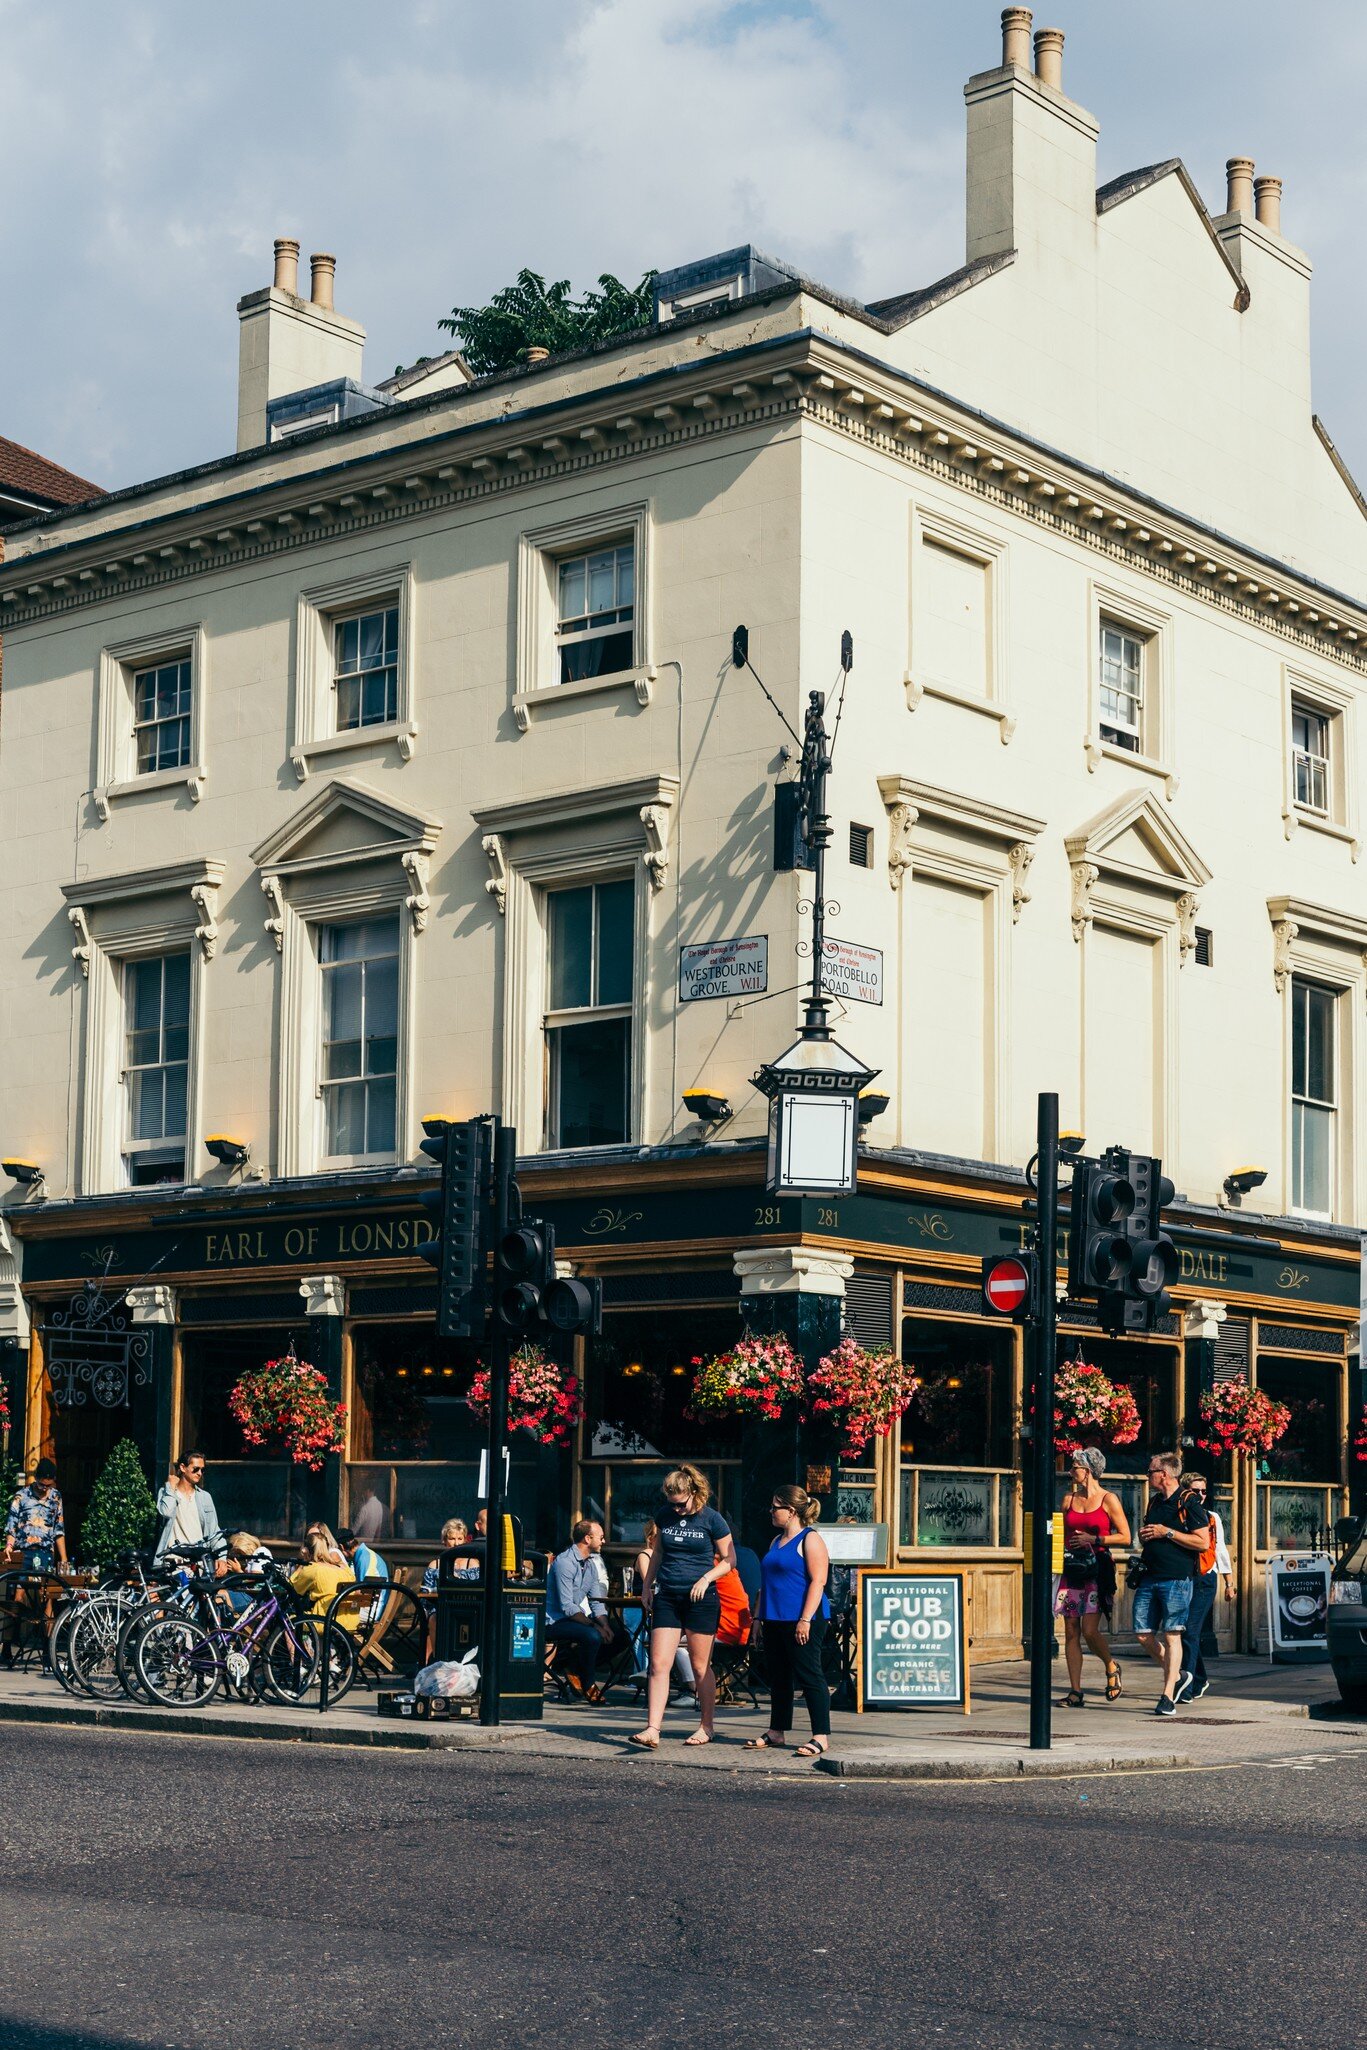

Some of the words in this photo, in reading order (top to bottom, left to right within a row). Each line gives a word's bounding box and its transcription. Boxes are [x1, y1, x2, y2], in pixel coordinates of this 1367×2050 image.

[685, 961, 763, 981] WESTBOURNE
[821, 962, 877, 985] PORTOBELLO
[691, 981, 730, 996] GROVE.
[755, 1208, 781, 1225] 281
[818, 1208, 839, 1227] 281
[206, 1232, 268, 1262] EARL
[284, 1227, 319, 1256] OF
[338, 1219, 440, 1253] LONSD
[1175, 1248, 1227, 1282] DALE
[883, 1597, 942, 1617] PUB
[874, 1620, 952, 1640] FOOD
[876, 1670, 951, 1683] COFFEE
